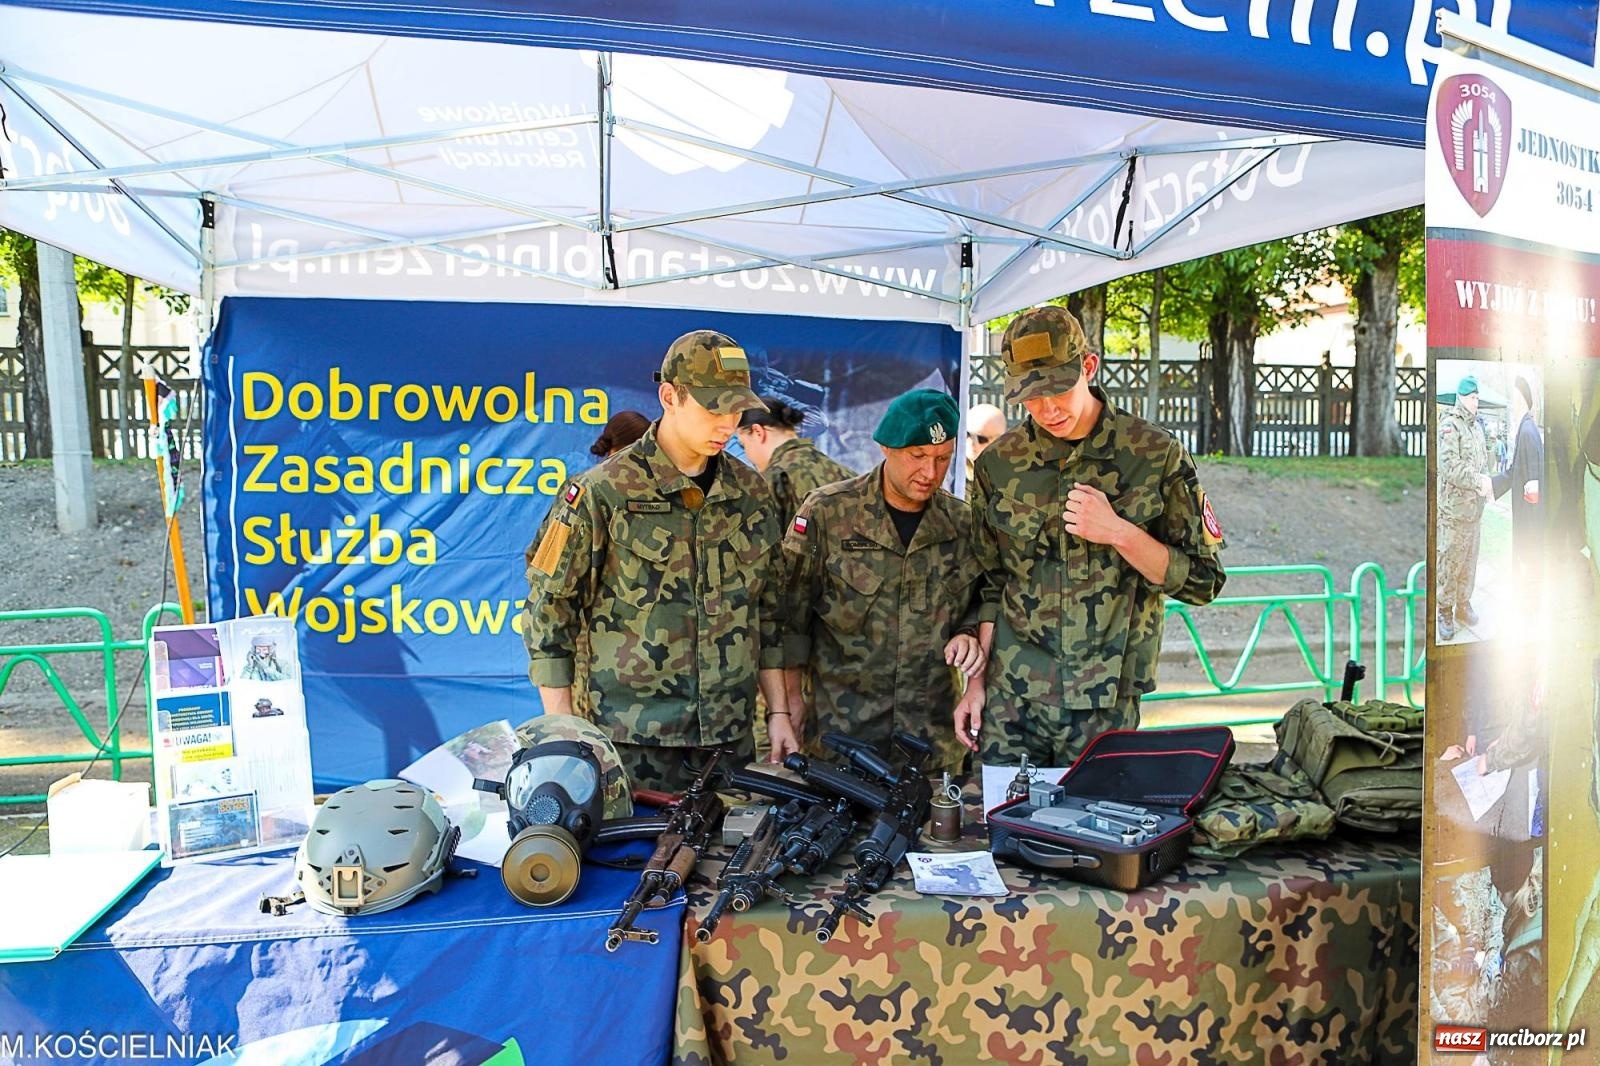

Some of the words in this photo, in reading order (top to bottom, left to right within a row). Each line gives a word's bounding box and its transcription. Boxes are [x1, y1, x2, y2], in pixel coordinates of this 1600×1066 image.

[1459, 83, 1497, 104] 3054
[1556, 180, 1593, 212] 3054
[242, 367, 609, 425] Dobrowolna
[243, 441, 567, 496] Zasadnicza
[242, 512, 438, 566] Służba
[175, 733, 211, 746] UWAGA!
